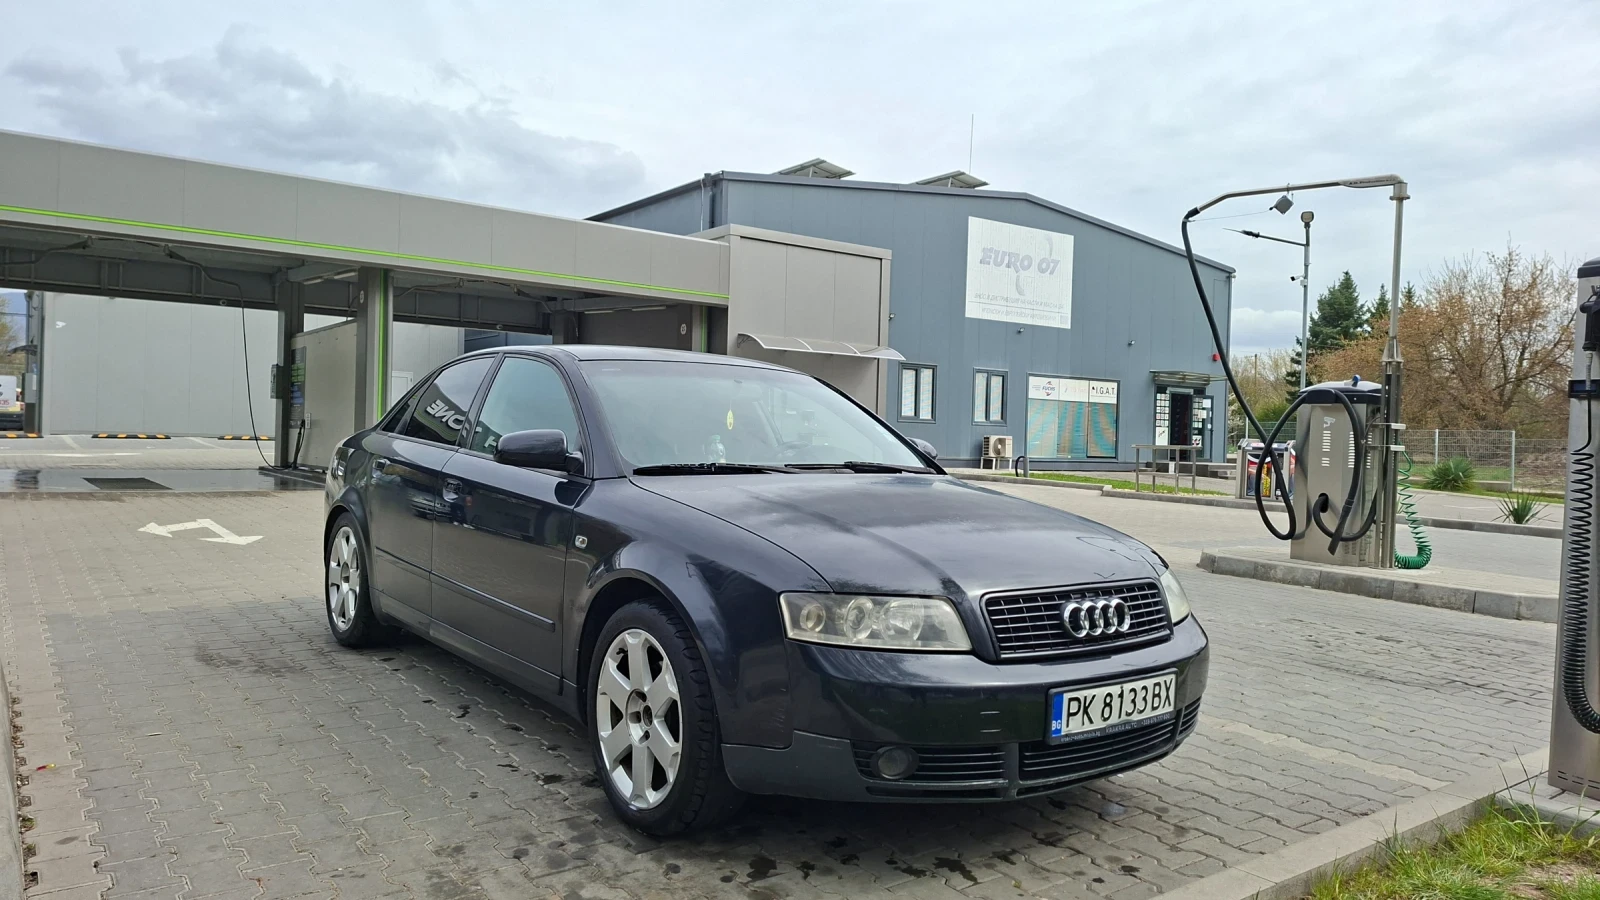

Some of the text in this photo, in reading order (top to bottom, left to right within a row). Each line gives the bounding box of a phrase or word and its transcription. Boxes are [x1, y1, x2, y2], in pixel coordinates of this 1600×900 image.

[979, 247, 1061, 275] EURO 07
[1066, 677, 1174, 729] PK 8133 BX
[1051, 719, 1062, 731] BG
